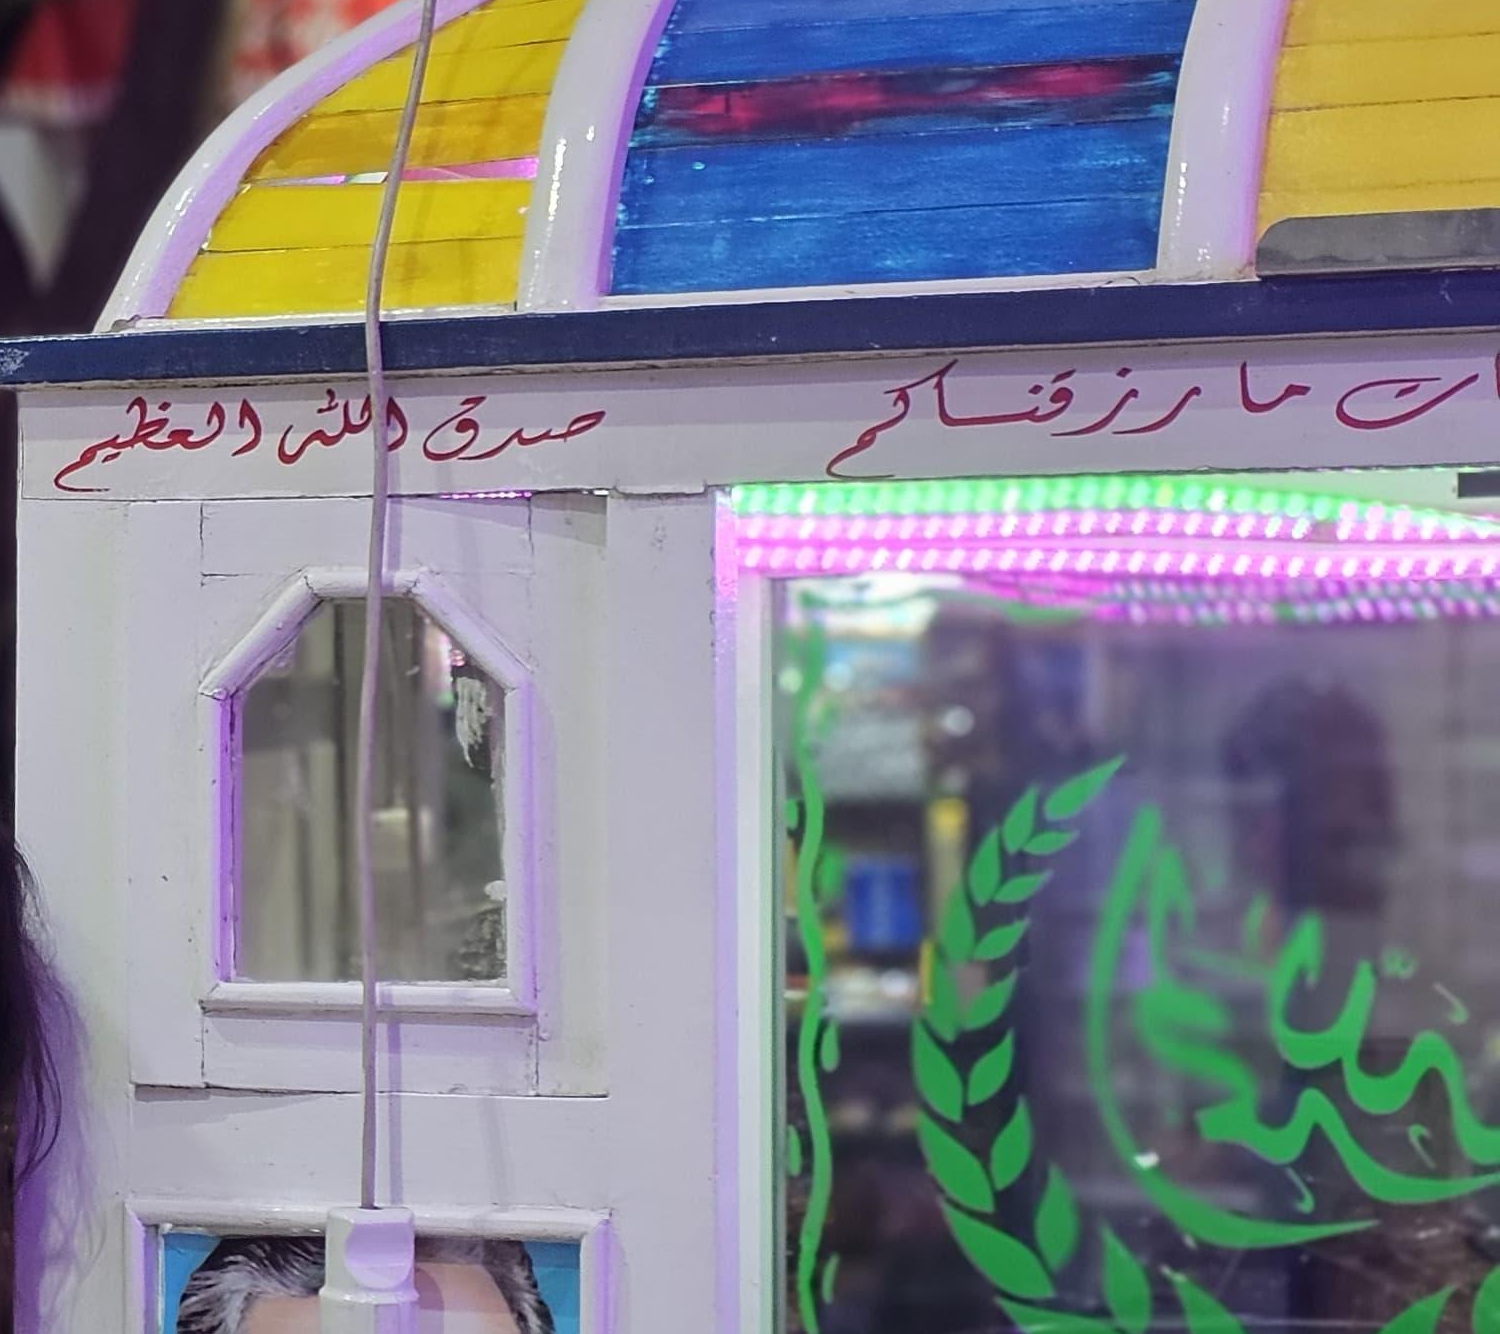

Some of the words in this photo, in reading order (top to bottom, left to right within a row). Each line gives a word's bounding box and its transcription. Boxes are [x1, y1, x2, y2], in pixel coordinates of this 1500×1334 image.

[276, 387, 409, 466] الله
[825, 358, 1202, 479] رزقناكم
[1238, 360, 1312, 414] ما
[52, 394, 263, 493] العظيم
[422, 394, 608, 463] صدق
